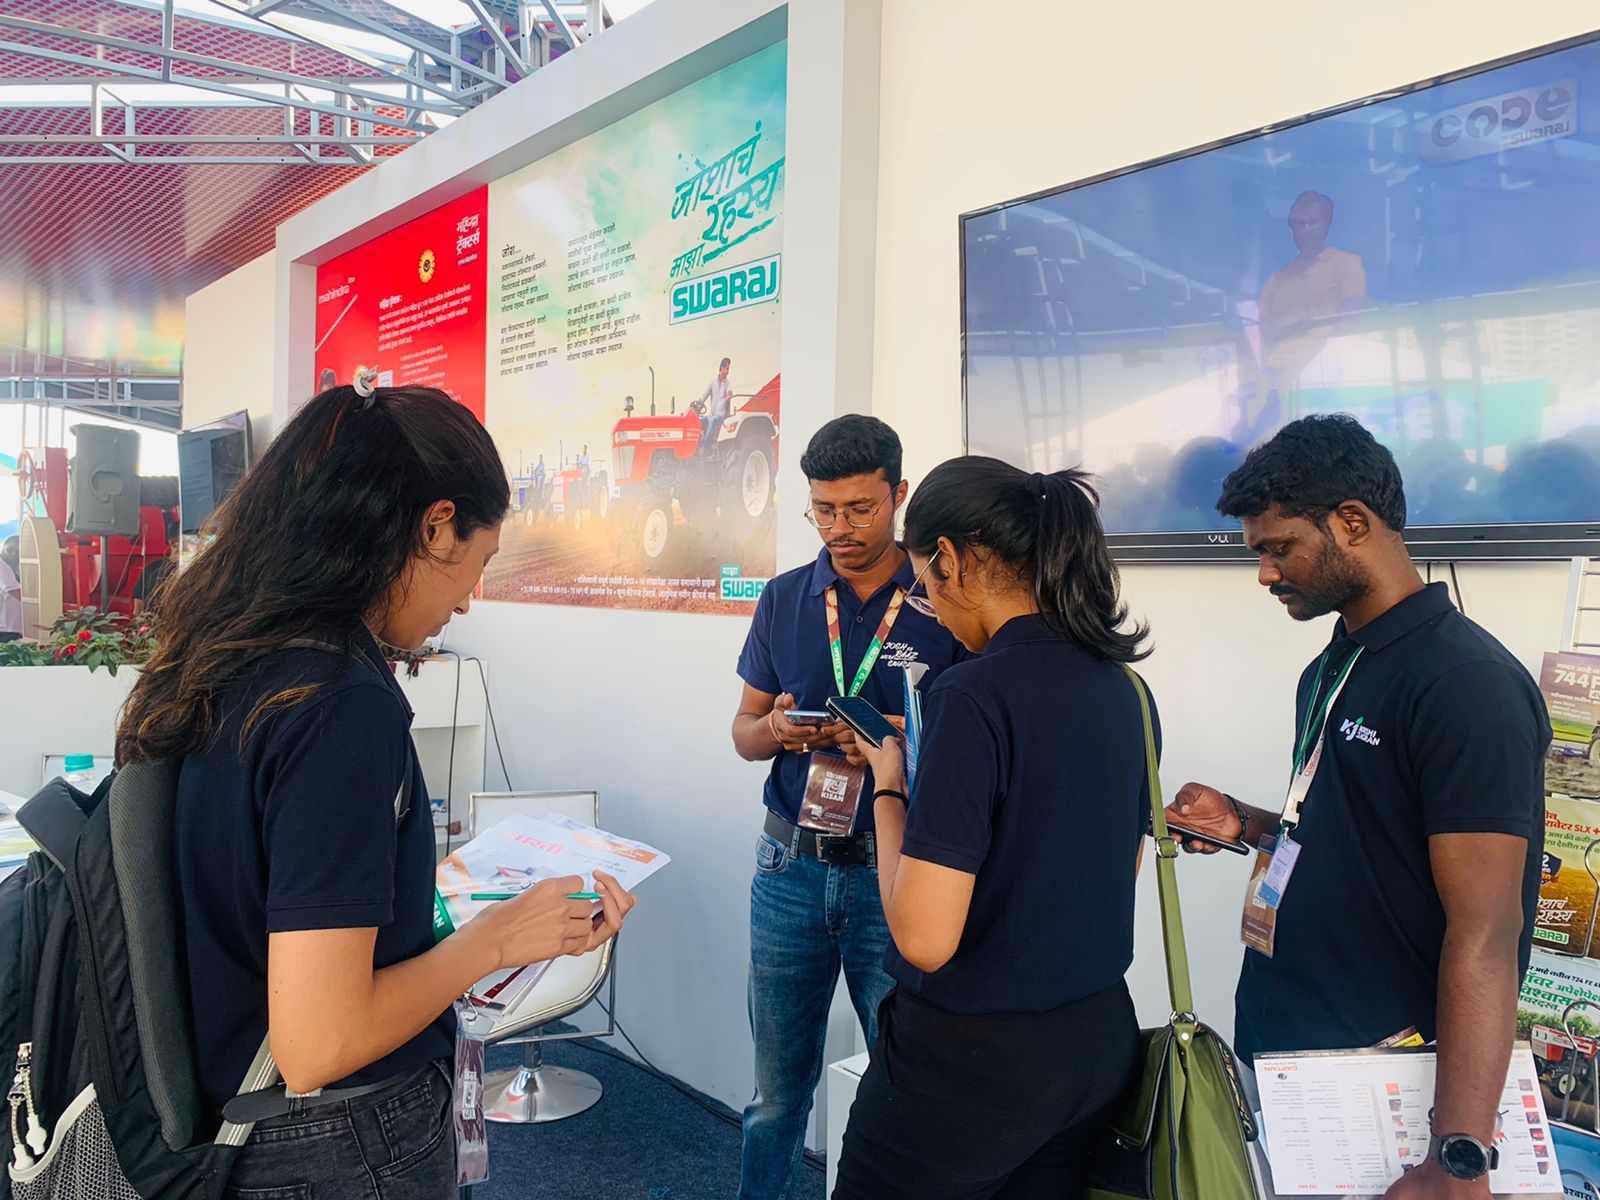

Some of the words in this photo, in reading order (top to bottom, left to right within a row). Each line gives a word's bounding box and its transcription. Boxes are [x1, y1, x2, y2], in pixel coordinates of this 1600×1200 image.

[702, 156, 786, 244] रहस्य
[670, 243, 706, 278] माझा
[673, 261, 777, 319] SWARAJ
[722, 580, 766, 598] SWAR
[1554, 669, 1590, 688] 744
[1574, 824, 1591, 834] SLX
[1534, 928, 1568, 943] ARAJ
[1525, 971, 1554, 988] ॉवर
